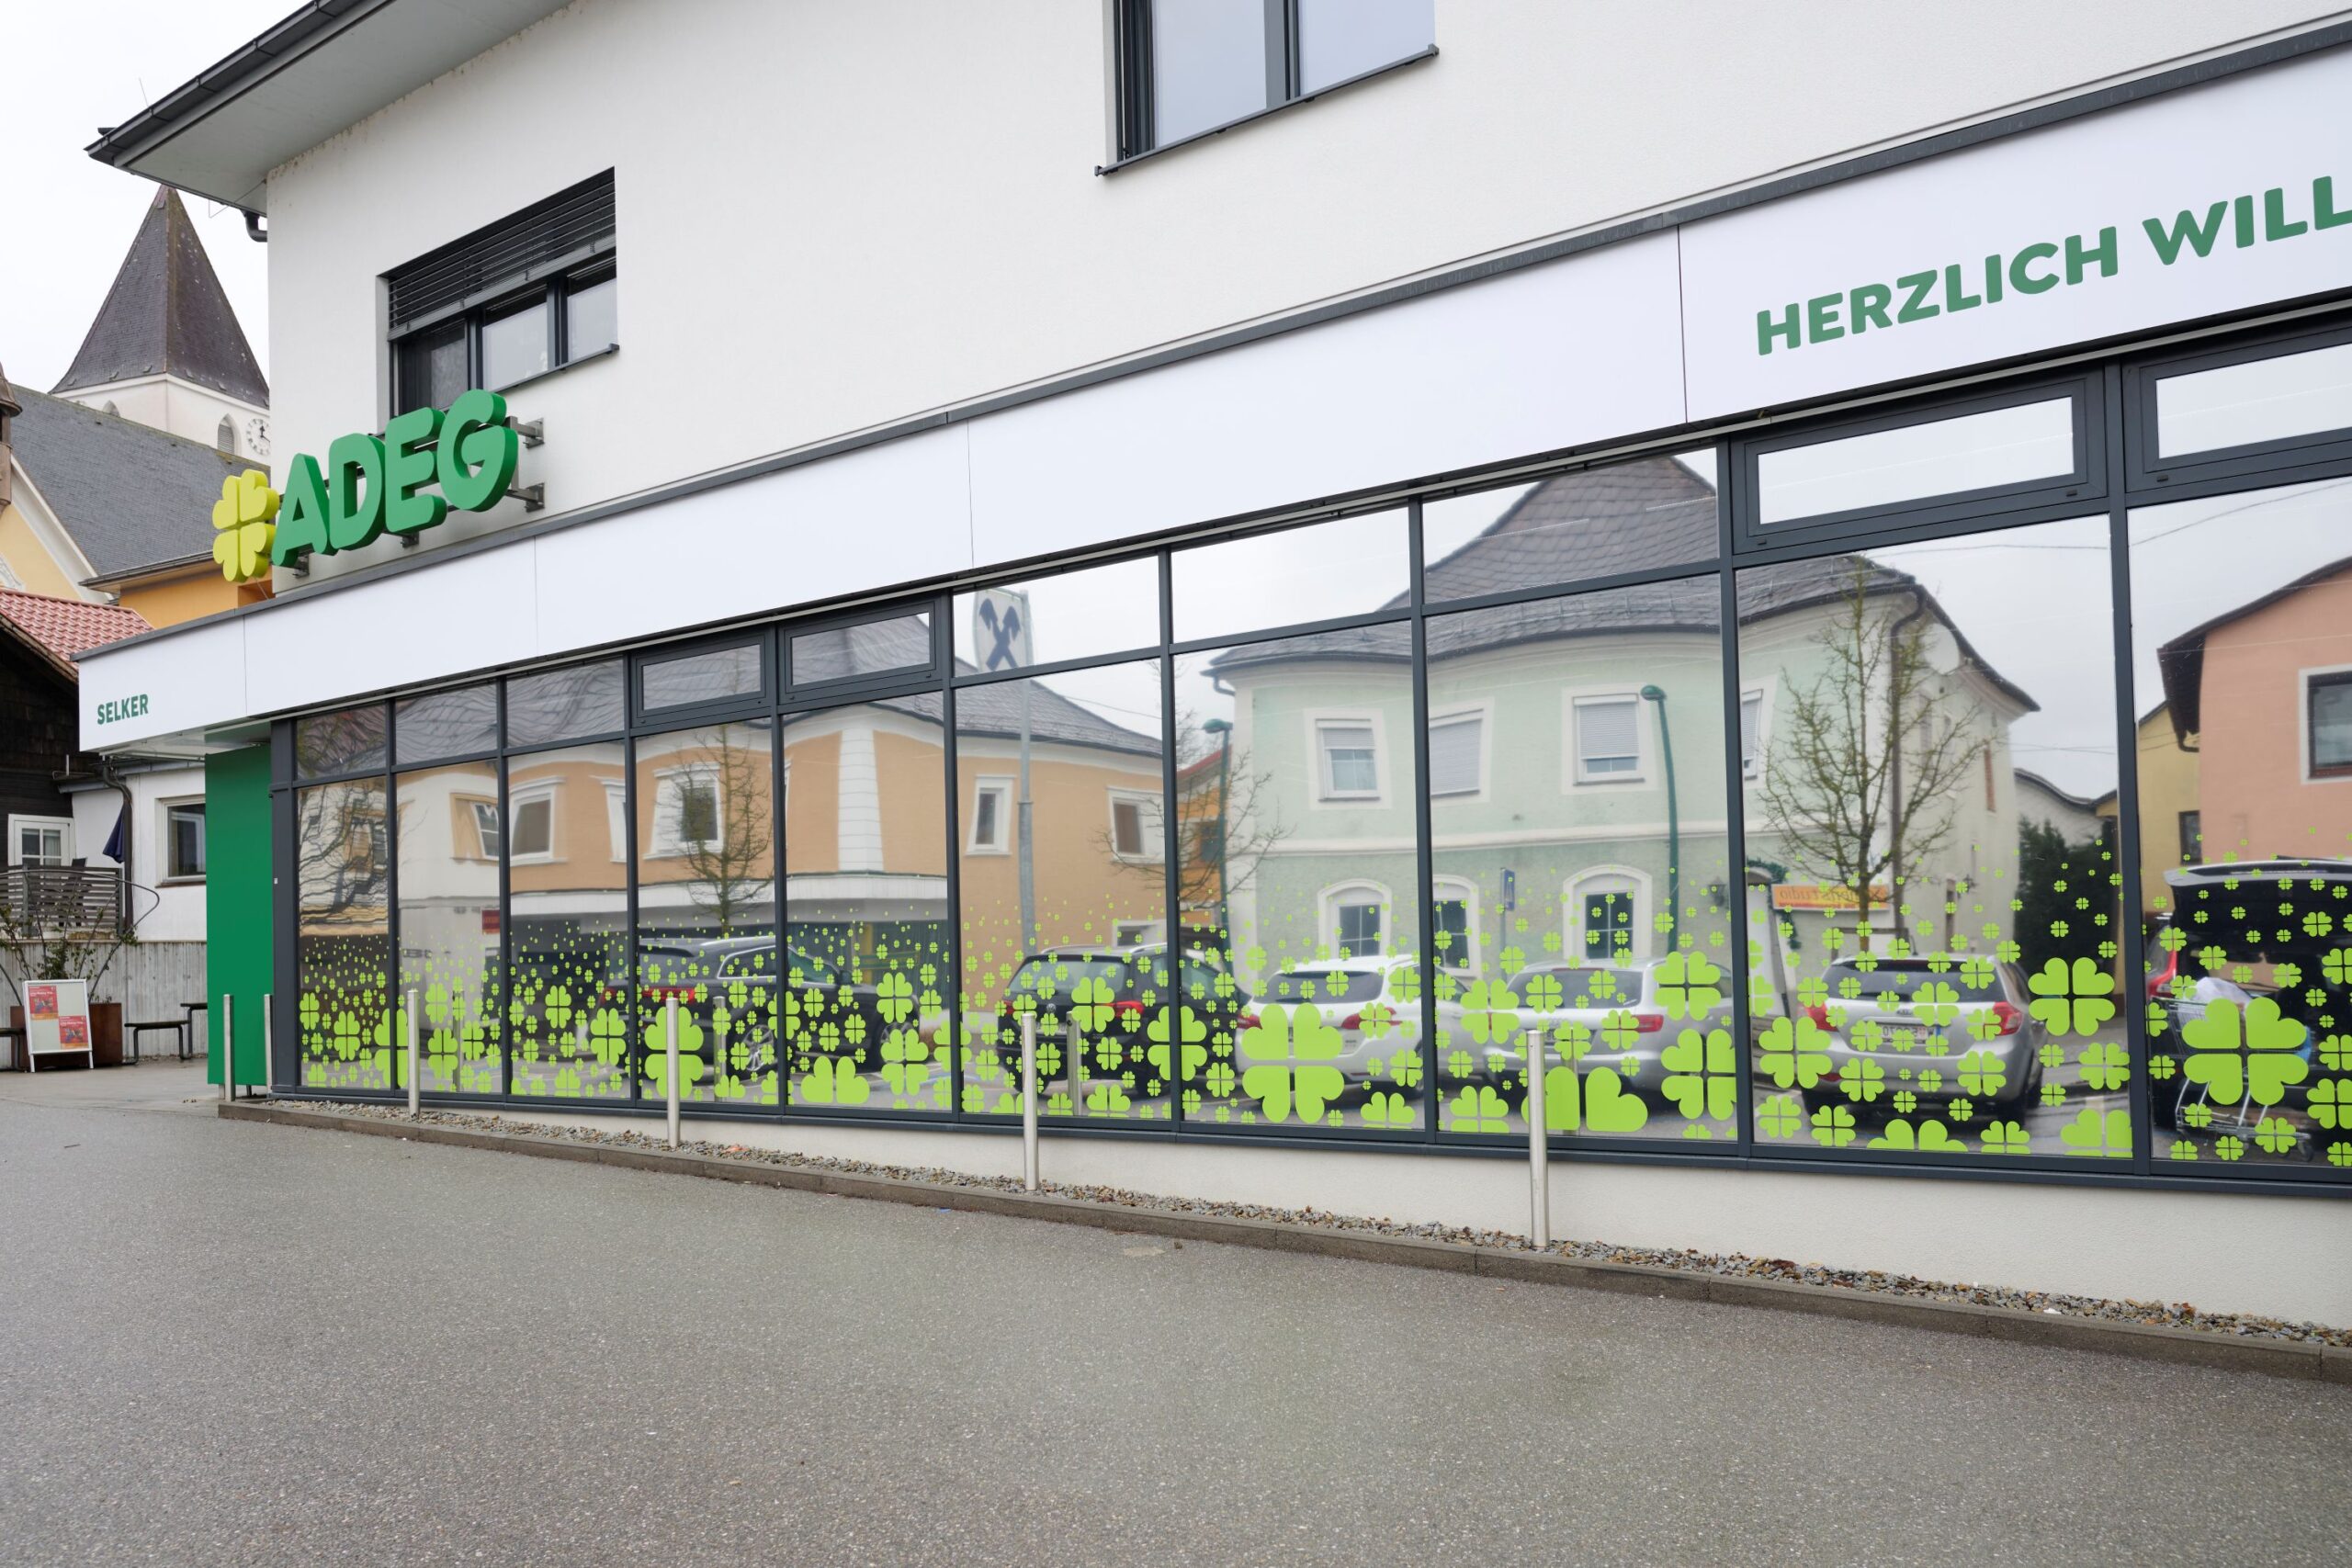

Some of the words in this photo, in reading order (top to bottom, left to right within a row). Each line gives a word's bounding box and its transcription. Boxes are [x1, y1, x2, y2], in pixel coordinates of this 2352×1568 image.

[1757, 226, 2119, 356] HERZLICH
[2142, 175, 2352, 265] WILL
[271, 389, 518, 567] ADEG
[97, 694, 149, 725] SELKER
